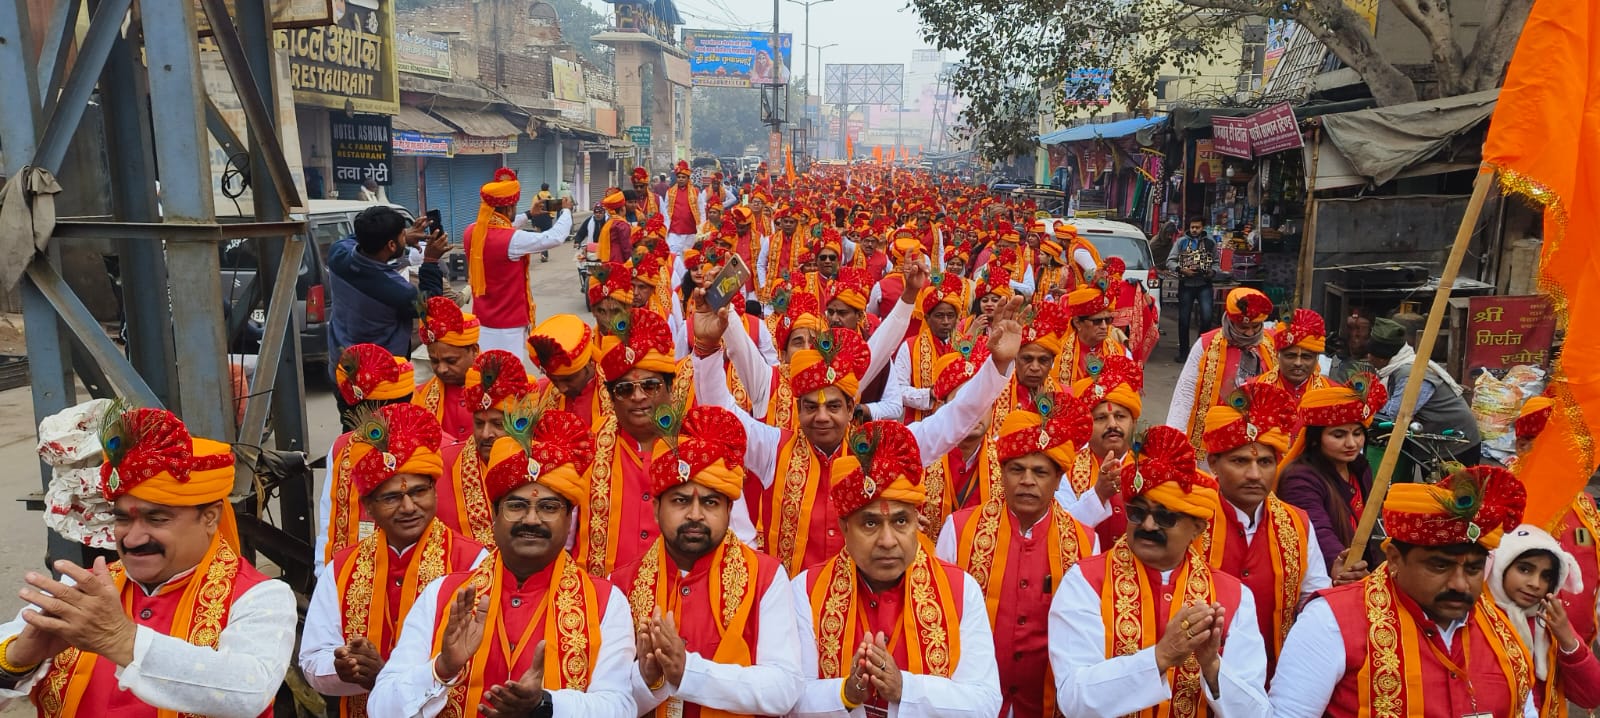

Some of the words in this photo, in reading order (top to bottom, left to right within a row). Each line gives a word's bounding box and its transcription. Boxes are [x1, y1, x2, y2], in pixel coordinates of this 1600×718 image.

[328, 13, 382, 71] अशोका
[292, 63, 374, 95] RESTAURANT
[333, 124, 355, 140] HOTEL
[358, 124, 388, 142] ASHOKA
[336, 150, 386, 160] RESTAURANT
[355, 143, 383, 151] FAMILY
[336, 166, 361, 180] तवा
[363, 162, 388, 182] रोटी
[1473, 306, 1504, 323] श्री
